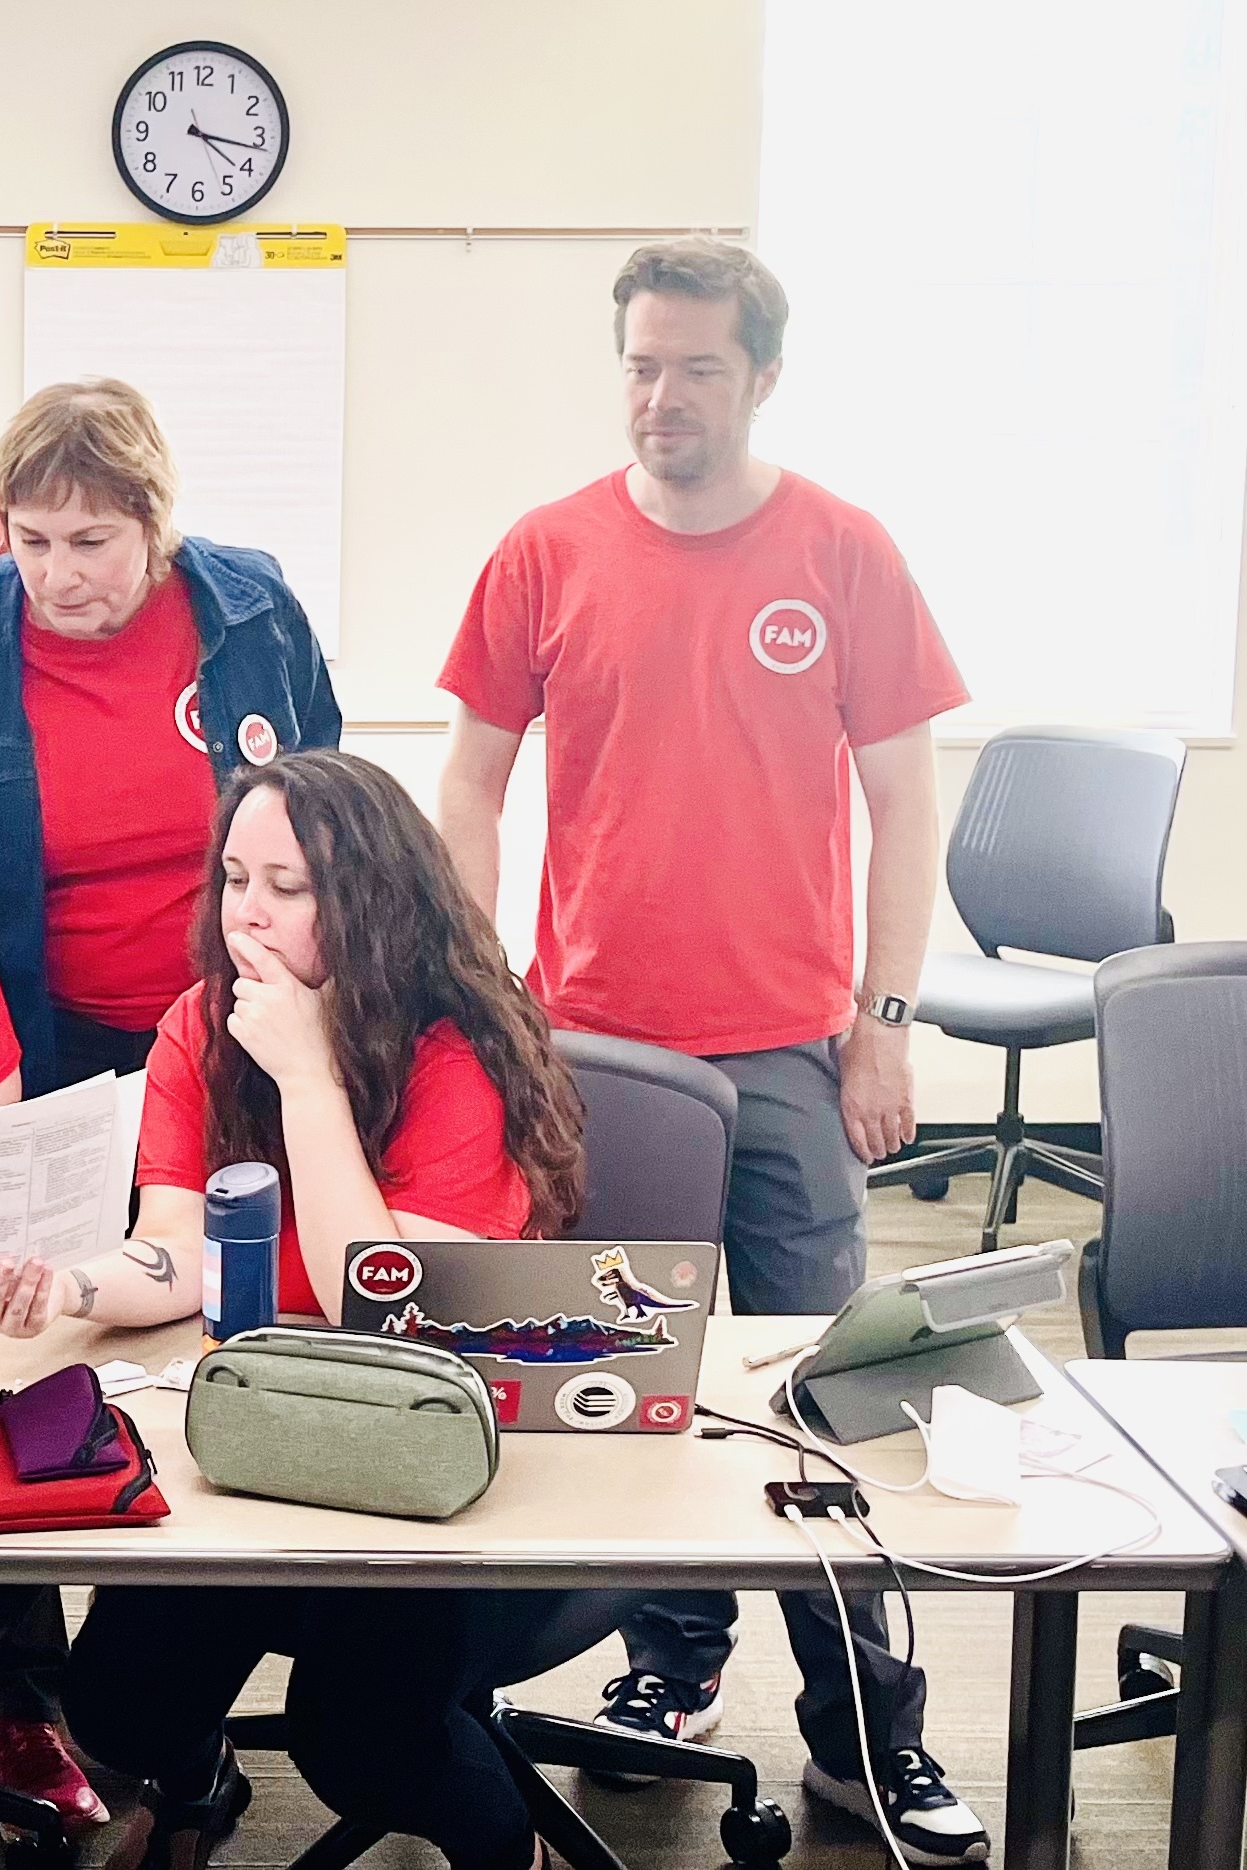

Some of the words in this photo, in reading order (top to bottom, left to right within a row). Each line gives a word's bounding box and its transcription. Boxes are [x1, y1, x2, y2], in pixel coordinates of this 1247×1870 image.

[168, 71, 184, 92] 11
[193, 65, 214, 87] 12
[227, 73, 235, 94] 1
[145, 91, 167, 112] 10
[245, 95, 260, 116] 2
[135, 120, 149, 142] 9
[252, 126, 266, 148] 3
[143, 151, 157, 173] 8
[239, 157, 254, 178] 4
[164, 172, 178, 194] 7
[191, 181, 205, 202] 6
[220, 174, 234, 196] 5
[764, 625, 812, 648] FAM
[247, 729, 270, 752] FAM
[362, 1266, 409, 1282] FAM
